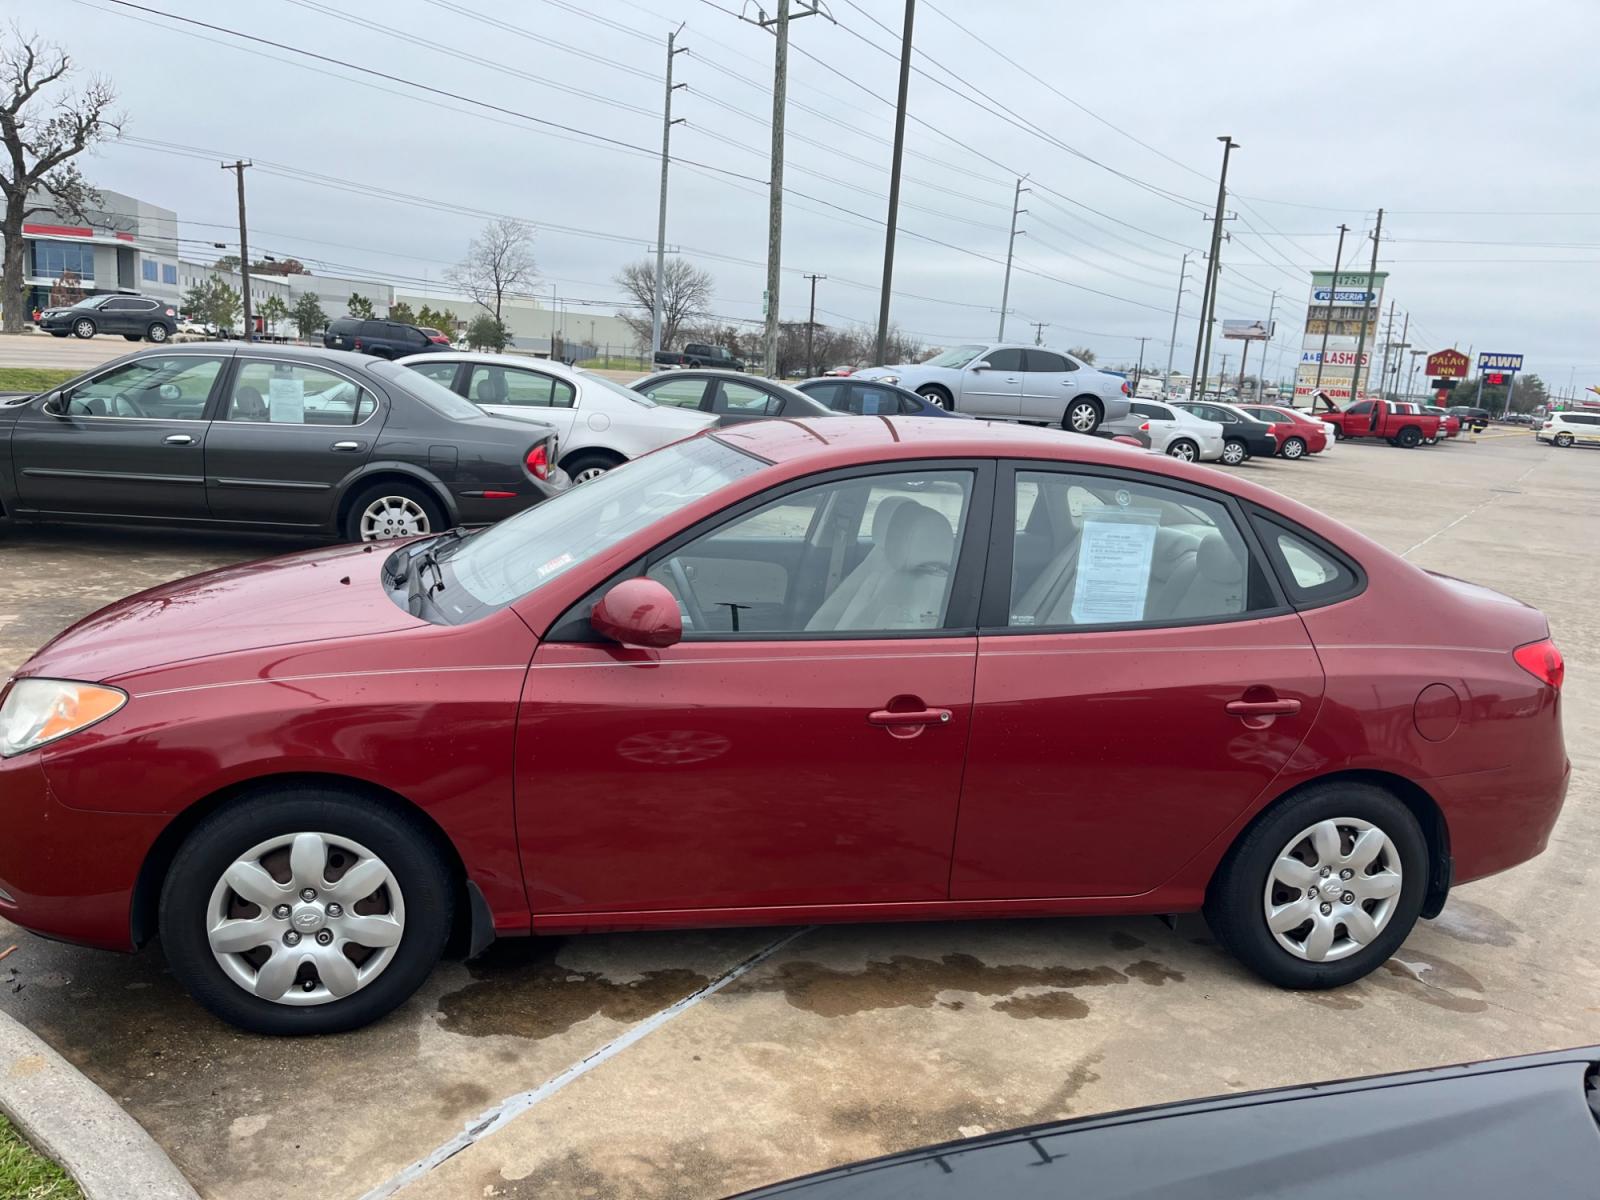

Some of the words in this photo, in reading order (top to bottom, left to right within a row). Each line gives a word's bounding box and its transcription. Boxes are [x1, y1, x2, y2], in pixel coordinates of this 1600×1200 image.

[1319, 292, 1363, 300] PUUSERIA
[1479, 355, 1521, 368] PAWN
[1438, 367, 1456, 375] INN
[1319, 378, 1365, 388] SHIPPIG
[1330, 390, 1363, 398] DONS
